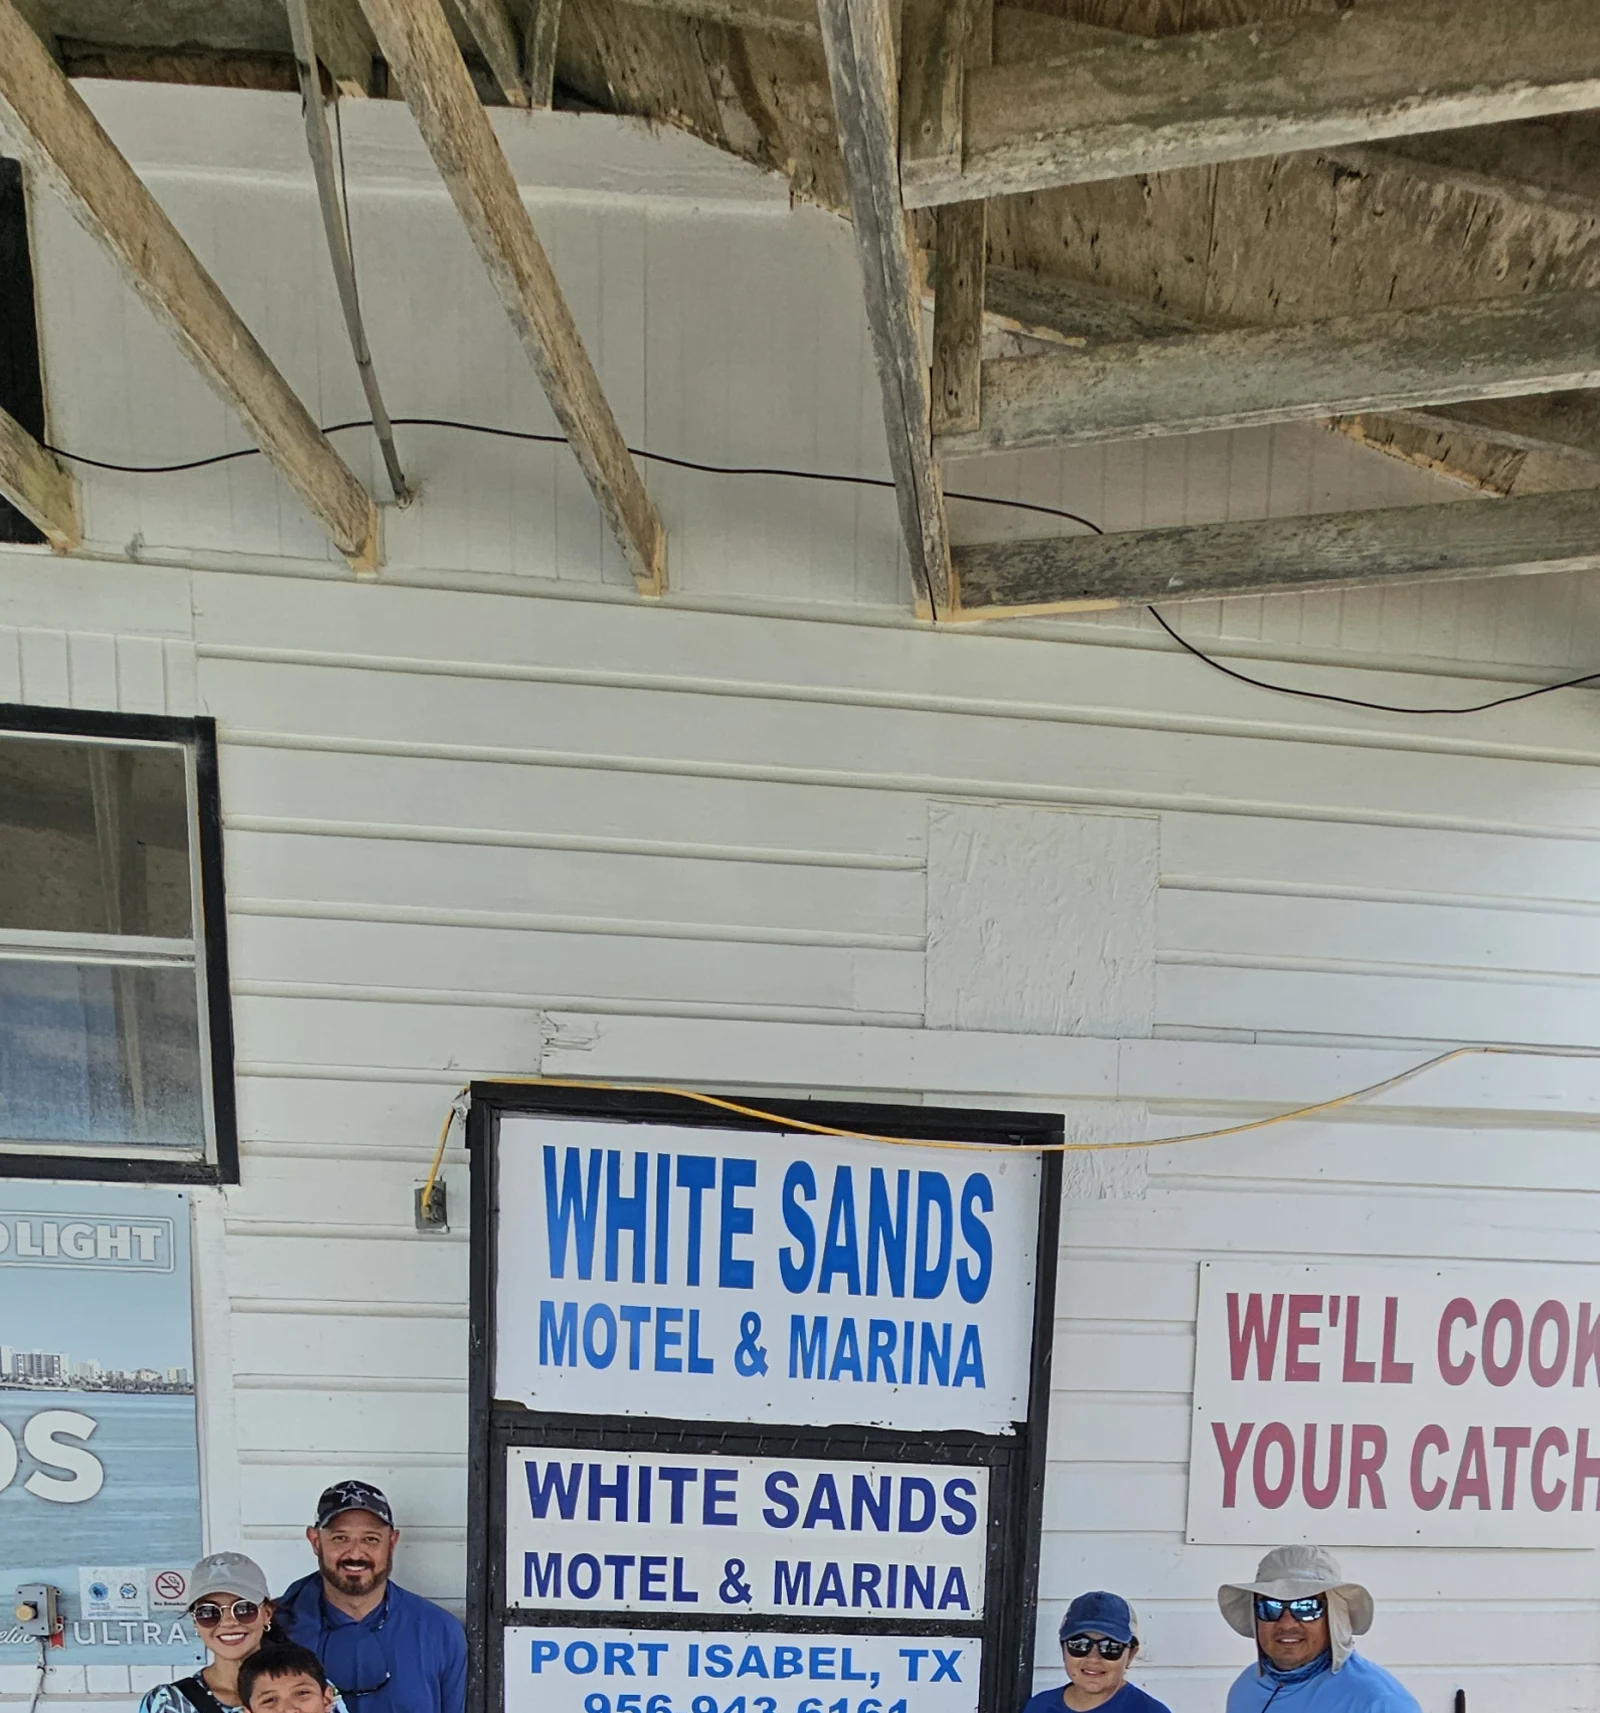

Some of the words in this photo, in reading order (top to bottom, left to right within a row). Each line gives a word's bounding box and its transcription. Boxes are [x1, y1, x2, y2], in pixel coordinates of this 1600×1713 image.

[16, 1221, 163, 1261] LIGHT
[544, 1146, 756, 1289] WHITE
[779, 1161, 993, 1303] SANDS
[540, 1301, 713, 1374] MOTEL
[735, 1311, 767, 1376] &
[789, 1315, 985, 1388] MARINA
[1226, 1292, 1413, 1384] WE'LL
[1437, 1297, 1600, 1388] COOK
[0, 1409, 104, 1503] S
[1211, 1421, 1388, 1510] YOUR
[1409, 1423, 1600, 1513] CATCH
[526, 1462, 737, 1525] WHITE
[763, 1472, 976, 1535] SANDS
[525, 1553, 697, 1601] MOTEL
[720, 1559, 751, 1603] &
[774, 1561, 969, 1610] MARINA
[74, 1622, 189, 1645] ULTRA
[532, 1641, 668, 1676] PORT
[689, 1644, 879, 1688] ISABEL,
[899, 1649, 961, 1682] TX
